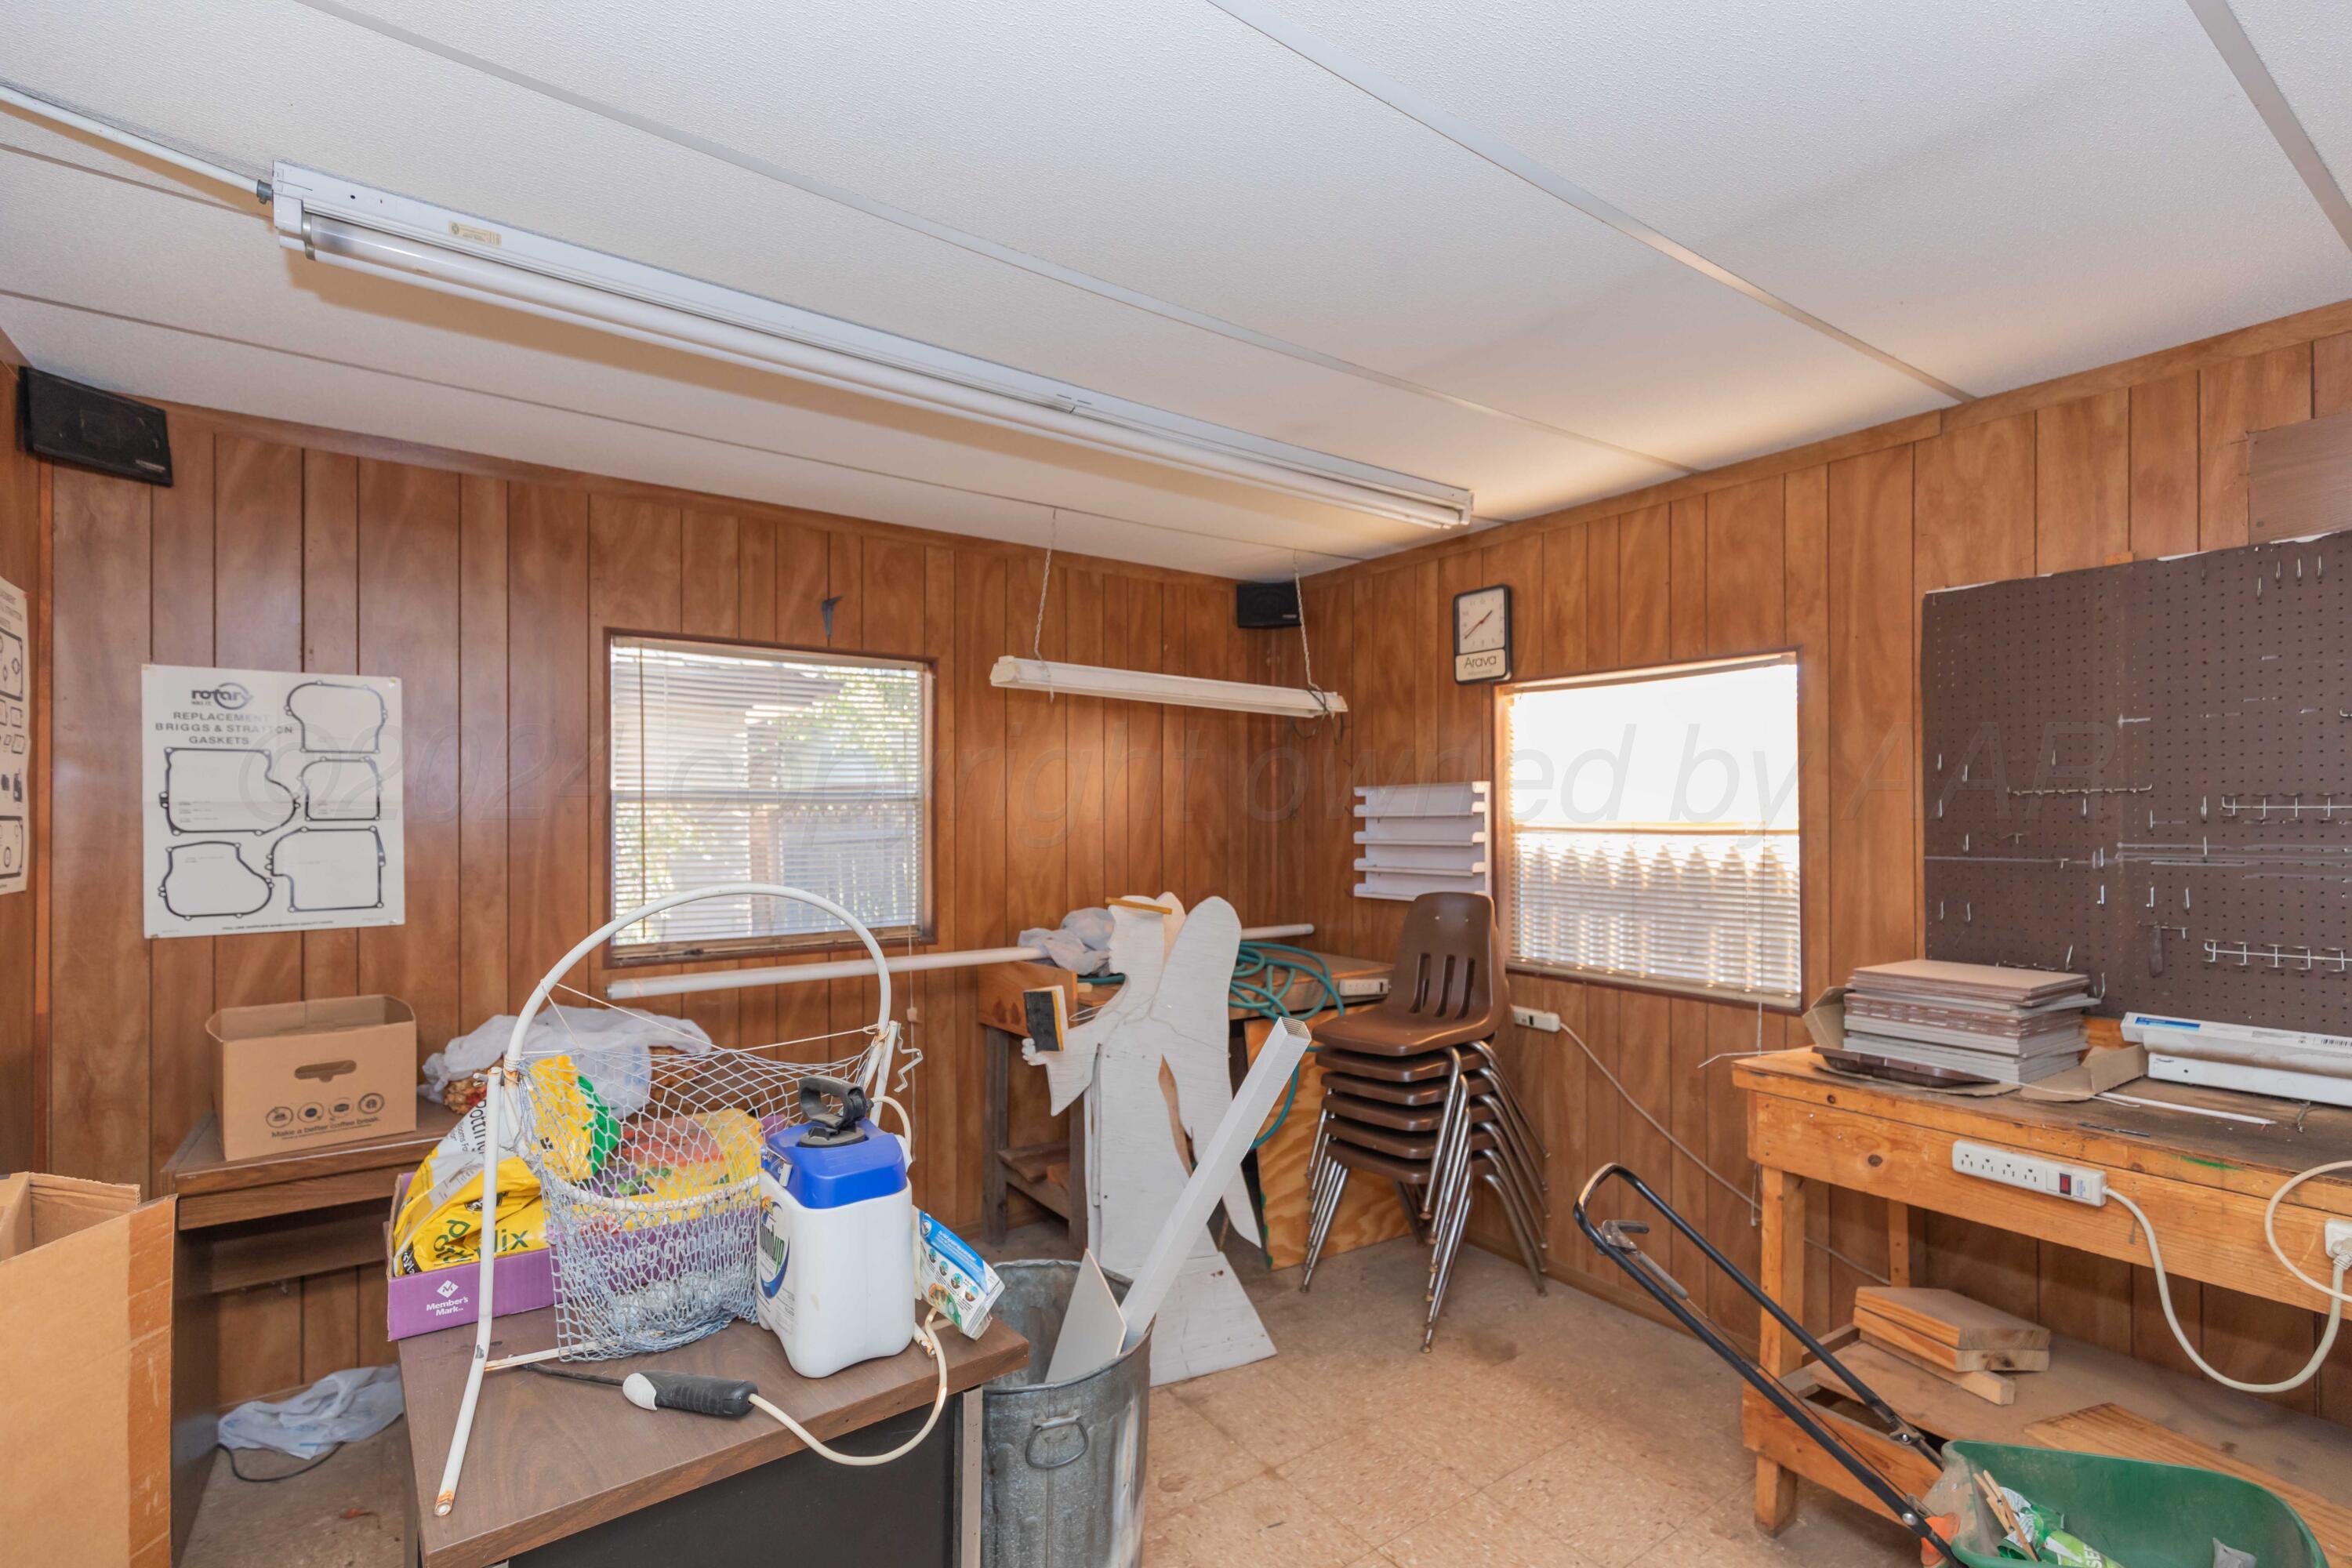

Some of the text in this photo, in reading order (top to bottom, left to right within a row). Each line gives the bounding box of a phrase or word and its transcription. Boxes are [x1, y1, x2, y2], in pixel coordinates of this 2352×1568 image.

[1464, 655, 1497, 670] Arava
[173, 712, 270, 722] REPLACEMENT
[155, 722, 210, 732] BRIGGS
[226, 724, 293, 734] STRATTON
[188, 735, 249, 745] GASKETS
[426, 1296, 469, 1312] Member's
[435, 1305, 459, 1317] Mark
